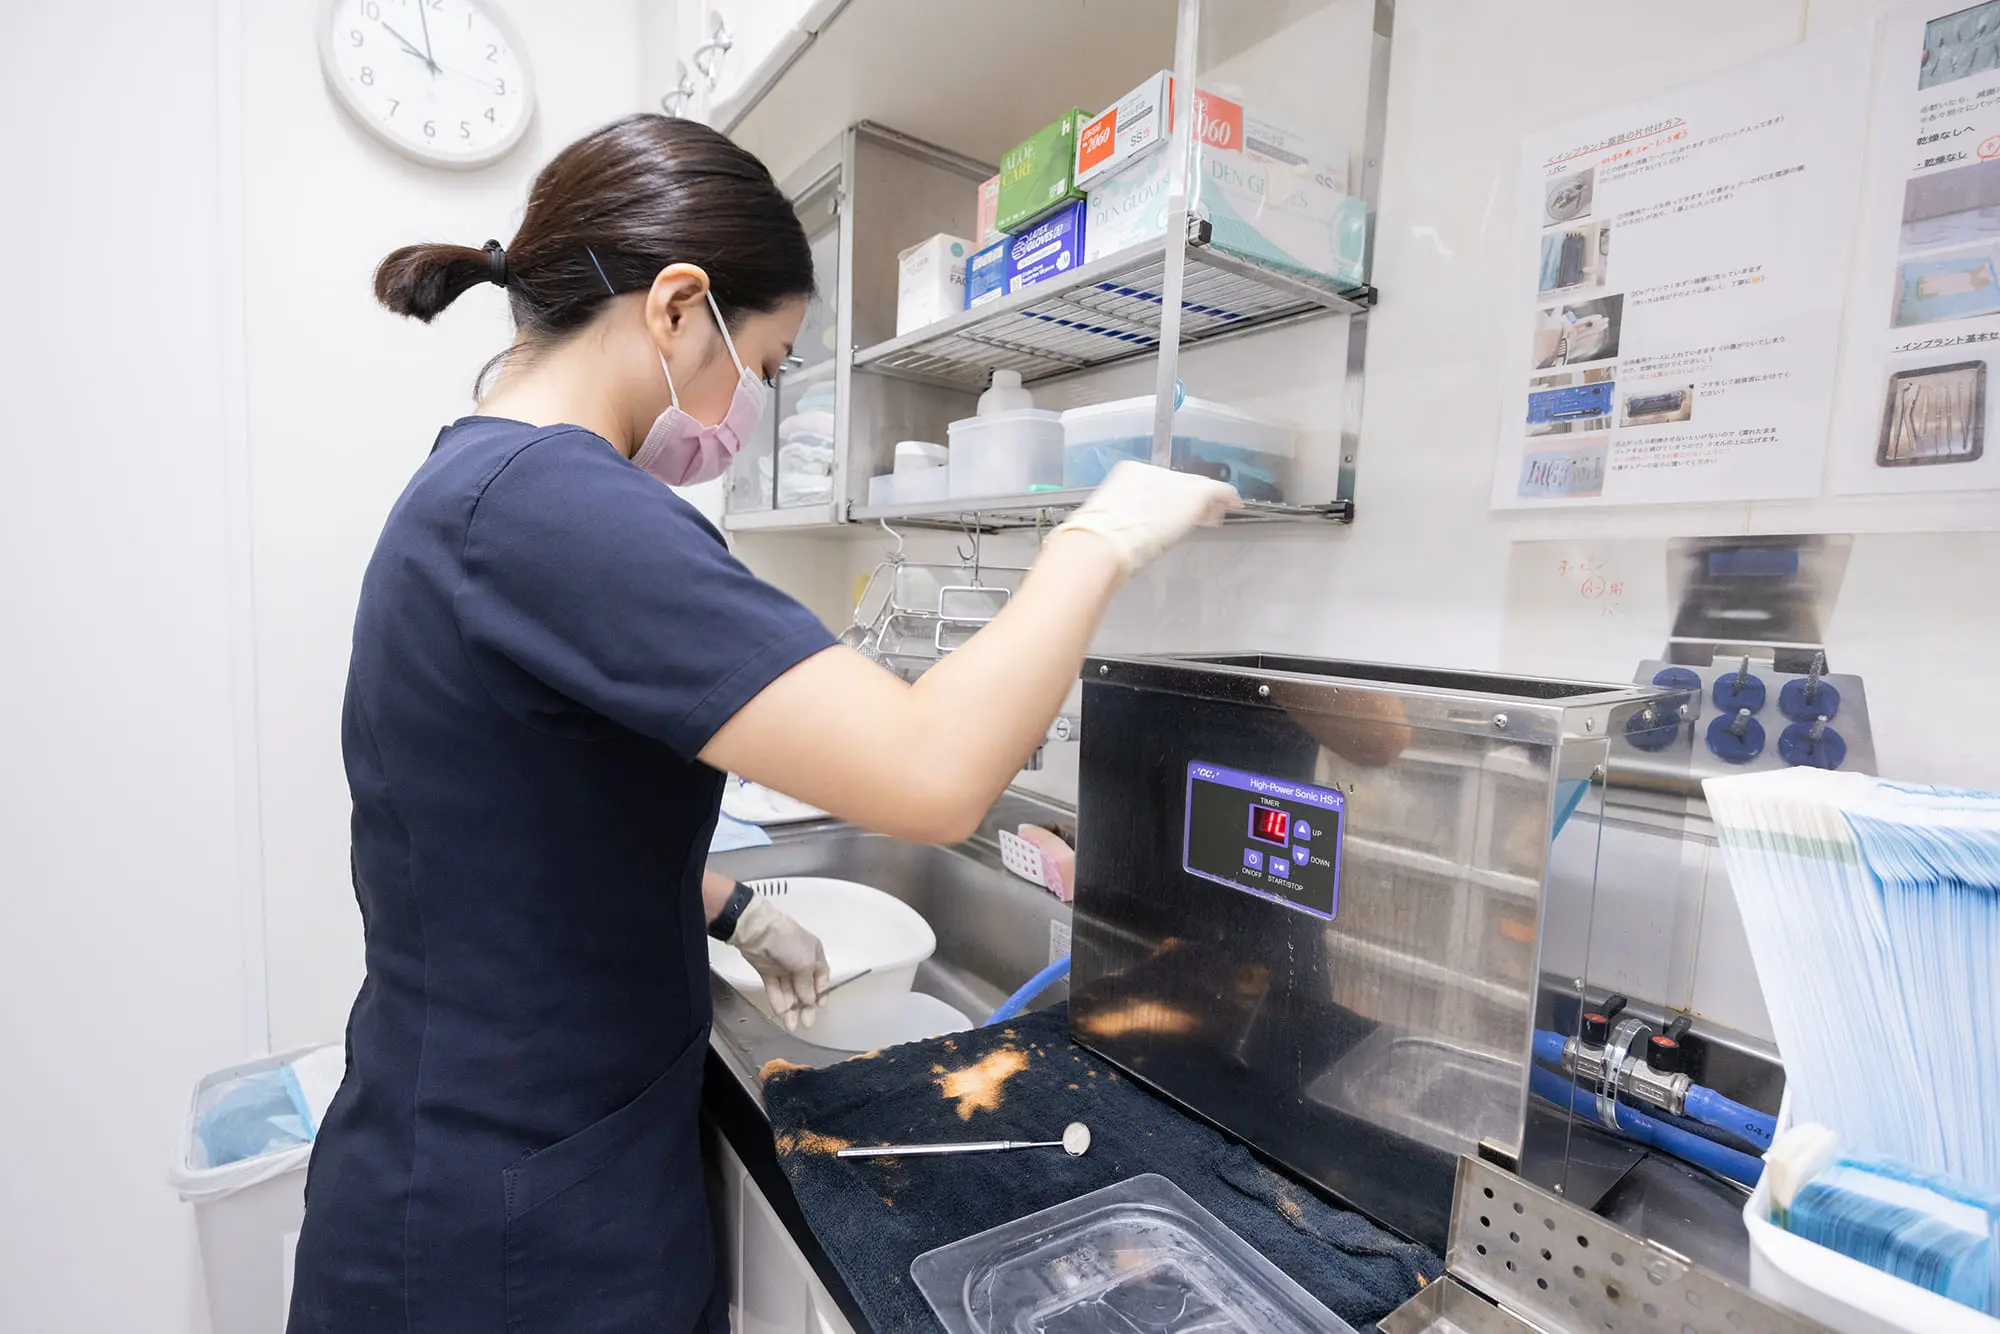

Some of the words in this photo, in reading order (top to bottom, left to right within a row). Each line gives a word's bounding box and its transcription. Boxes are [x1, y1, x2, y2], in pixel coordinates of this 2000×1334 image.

[360, 0, 380, 21] 10
[467, 13, 472, 30] 1
[351, 29, 364, 48] 9
[486, 43, 498, 62] 2
[359, 66, 374, 86] 8
[494, 78, 506, 96] 3
[387, 98, 400, 116] 7
[483, 107, 495, 124] 4
[423, 120, 436, 138] 6
[459, 120, 471, 139] 5
[1006, 140, 1036, 170] ALOE
[1001, 159, 1032, 187] CARE
[1212, 159, 1244, 188] DEN
[1250, 778, 1294, 797] High-Power
[1295, 788, 1318, 802] Sonic
[1260, 797, 1280, 808] TIMER
[1312, 829, 1323, 838] UP
[1310, 856, 1331, 868] DOWN
[1241, 867, 1263, 879] ON/OFF
[1267, 876, 1304, 891] START/STOP
